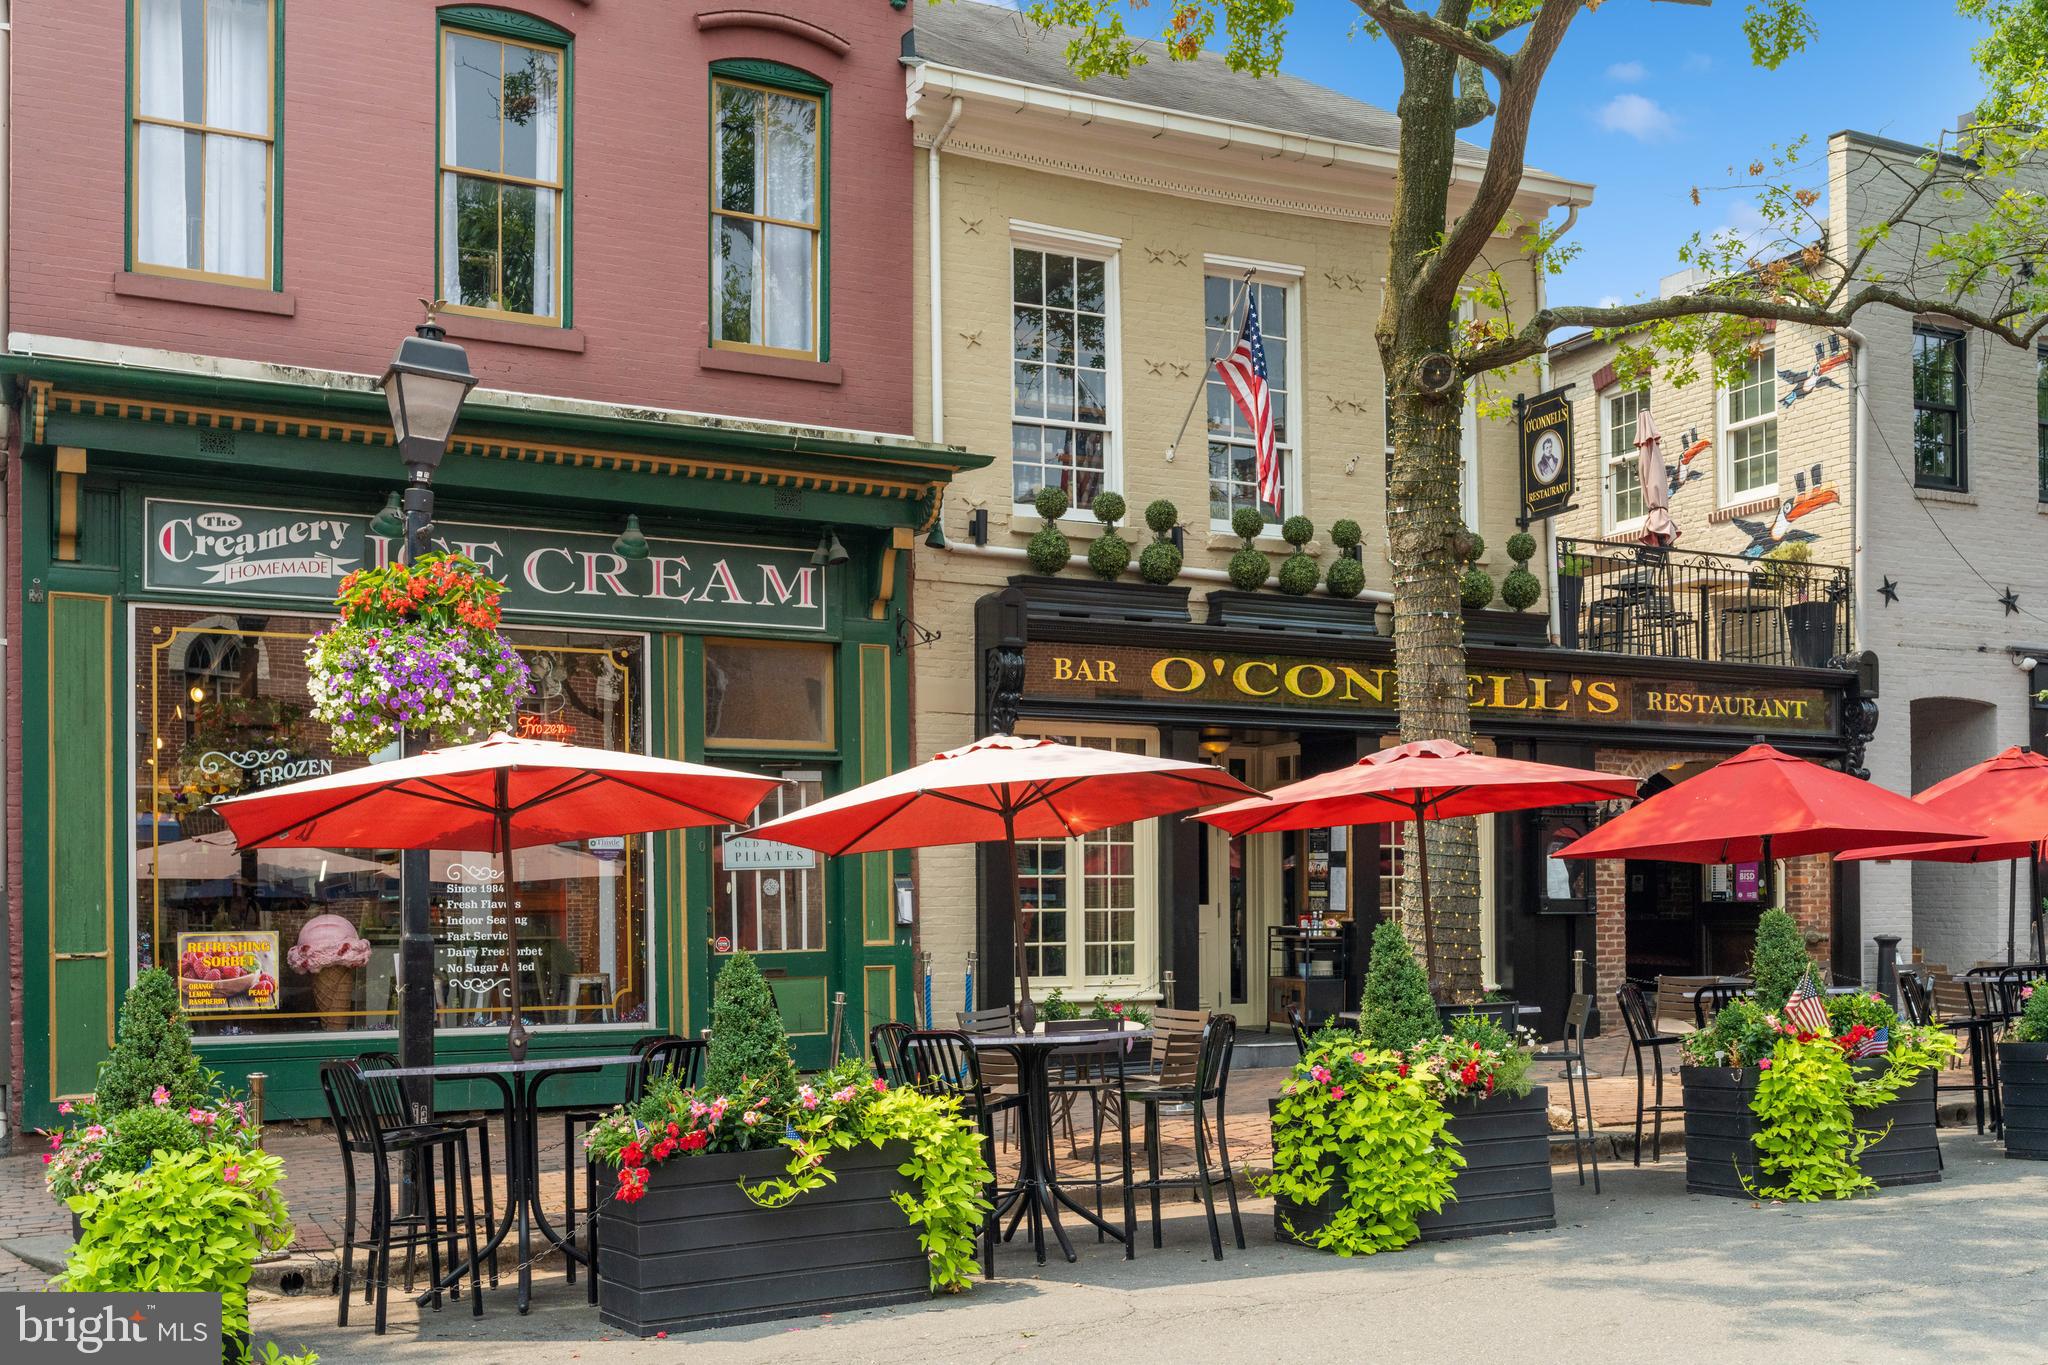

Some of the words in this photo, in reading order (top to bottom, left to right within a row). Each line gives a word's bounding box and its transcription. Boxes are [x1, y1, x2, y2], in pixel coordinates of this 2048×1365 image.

[1526, 407, 1568, 433] O'CONNELL'S
[1528, 482, 1568, 502] RESTAURANT
[203, 515, 238, 527] The
[158, 517, 350, 563] Creamery
[230, 560, 328, 580] HOMEMADE
[523, 546, 818, 609] CREAM
[1053, 657, 1119, 683] BAR
[1647, 691, 1809, 720] RESTAURANT
[515, 716, 567, 739] Frozen
[259, 759, 333, 786] FROZEN
[734, 850, 804, 862] PILATES
[446, 884, 478, 893] Since
[480, 884, 505, 893] 1984
[446, 900, 478, 909] Fresh
[480, 900, 521, 909] Flavs
[446, 916, 484, 925] Indoor
[486, 916, 528, 926] Seang
[446, 932, 471, 941] Fast
[473, 931, 510, 941] Servic
[187, 941, 271, 952] REFRESHING
[447, 948, 479, 958] Dairy
[481, 947, 505, 956] Free
[203, 955, 256, 968] SORBET
[447, 964, 463, 973] No
[465, 963, 499, 974] Sugar
[188, 997, 227, 1005] RASPBERRY
